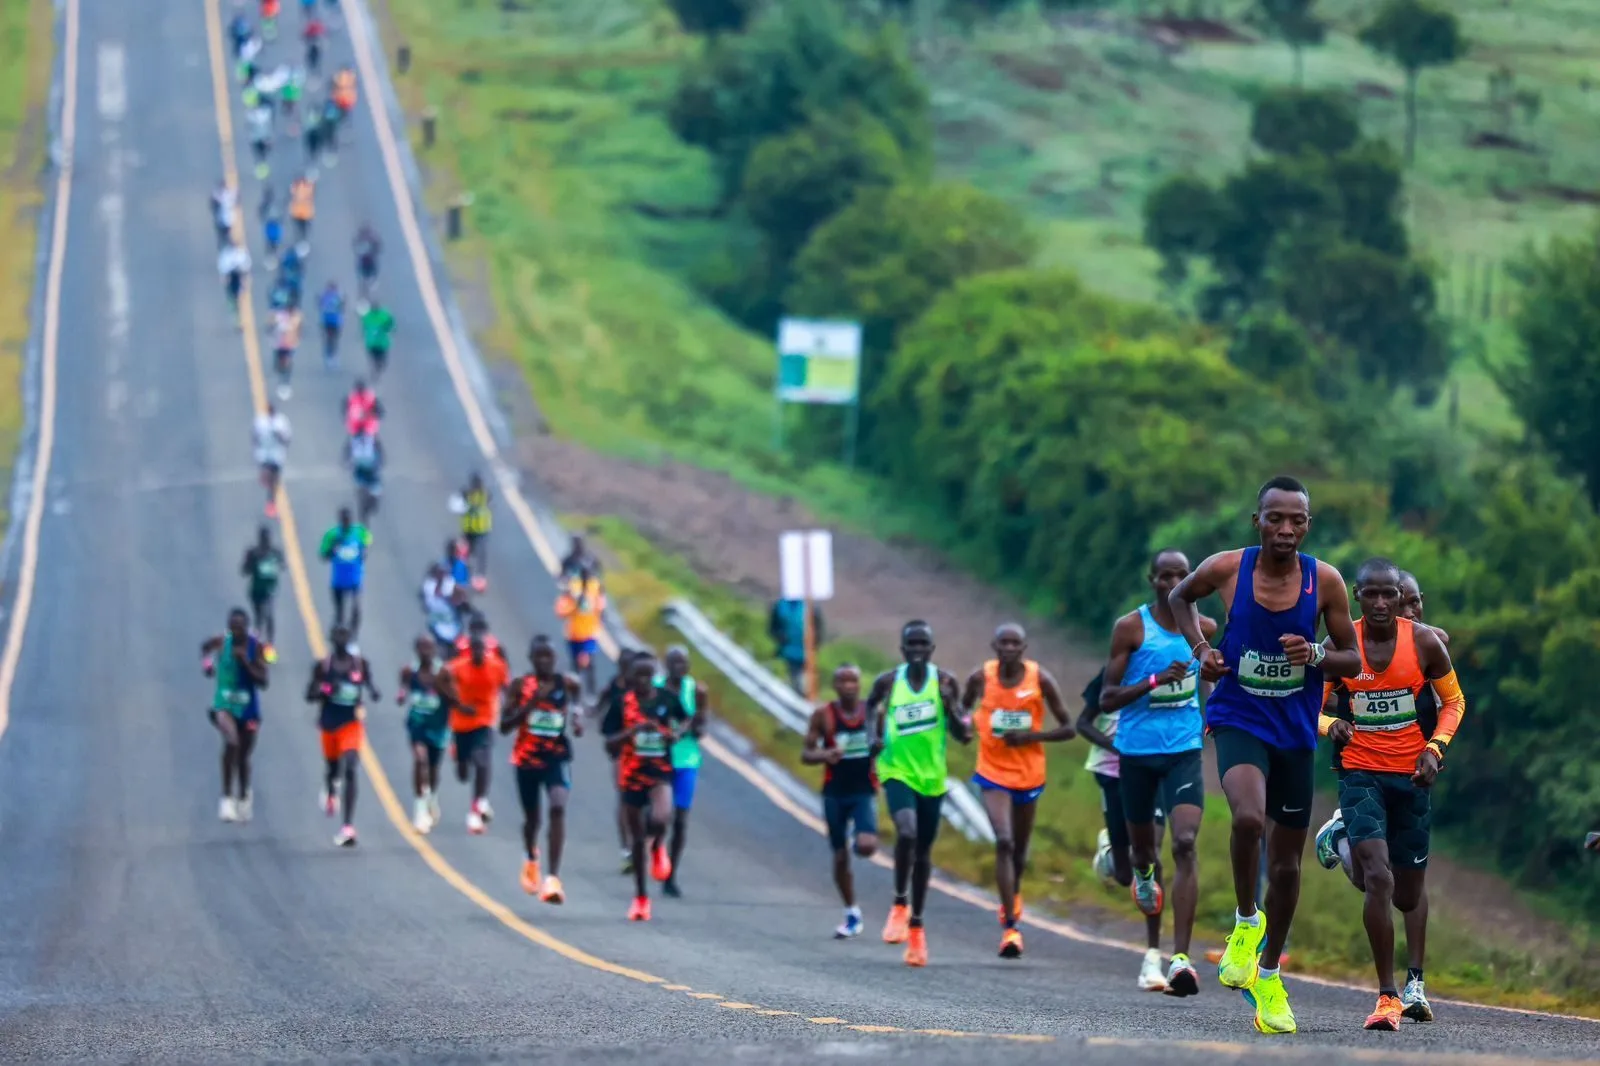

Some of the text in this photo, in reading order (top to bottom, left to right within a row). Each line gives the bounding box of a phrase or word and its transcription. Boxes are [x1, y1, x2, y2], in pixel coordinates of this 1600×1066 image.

[1261, 654, 1274, 662] HALF
[1254, 664, 1292, 678] 486
[1382, 689, 1408, 697] MARATHON
[1367, 700, 1399, 714] 491
